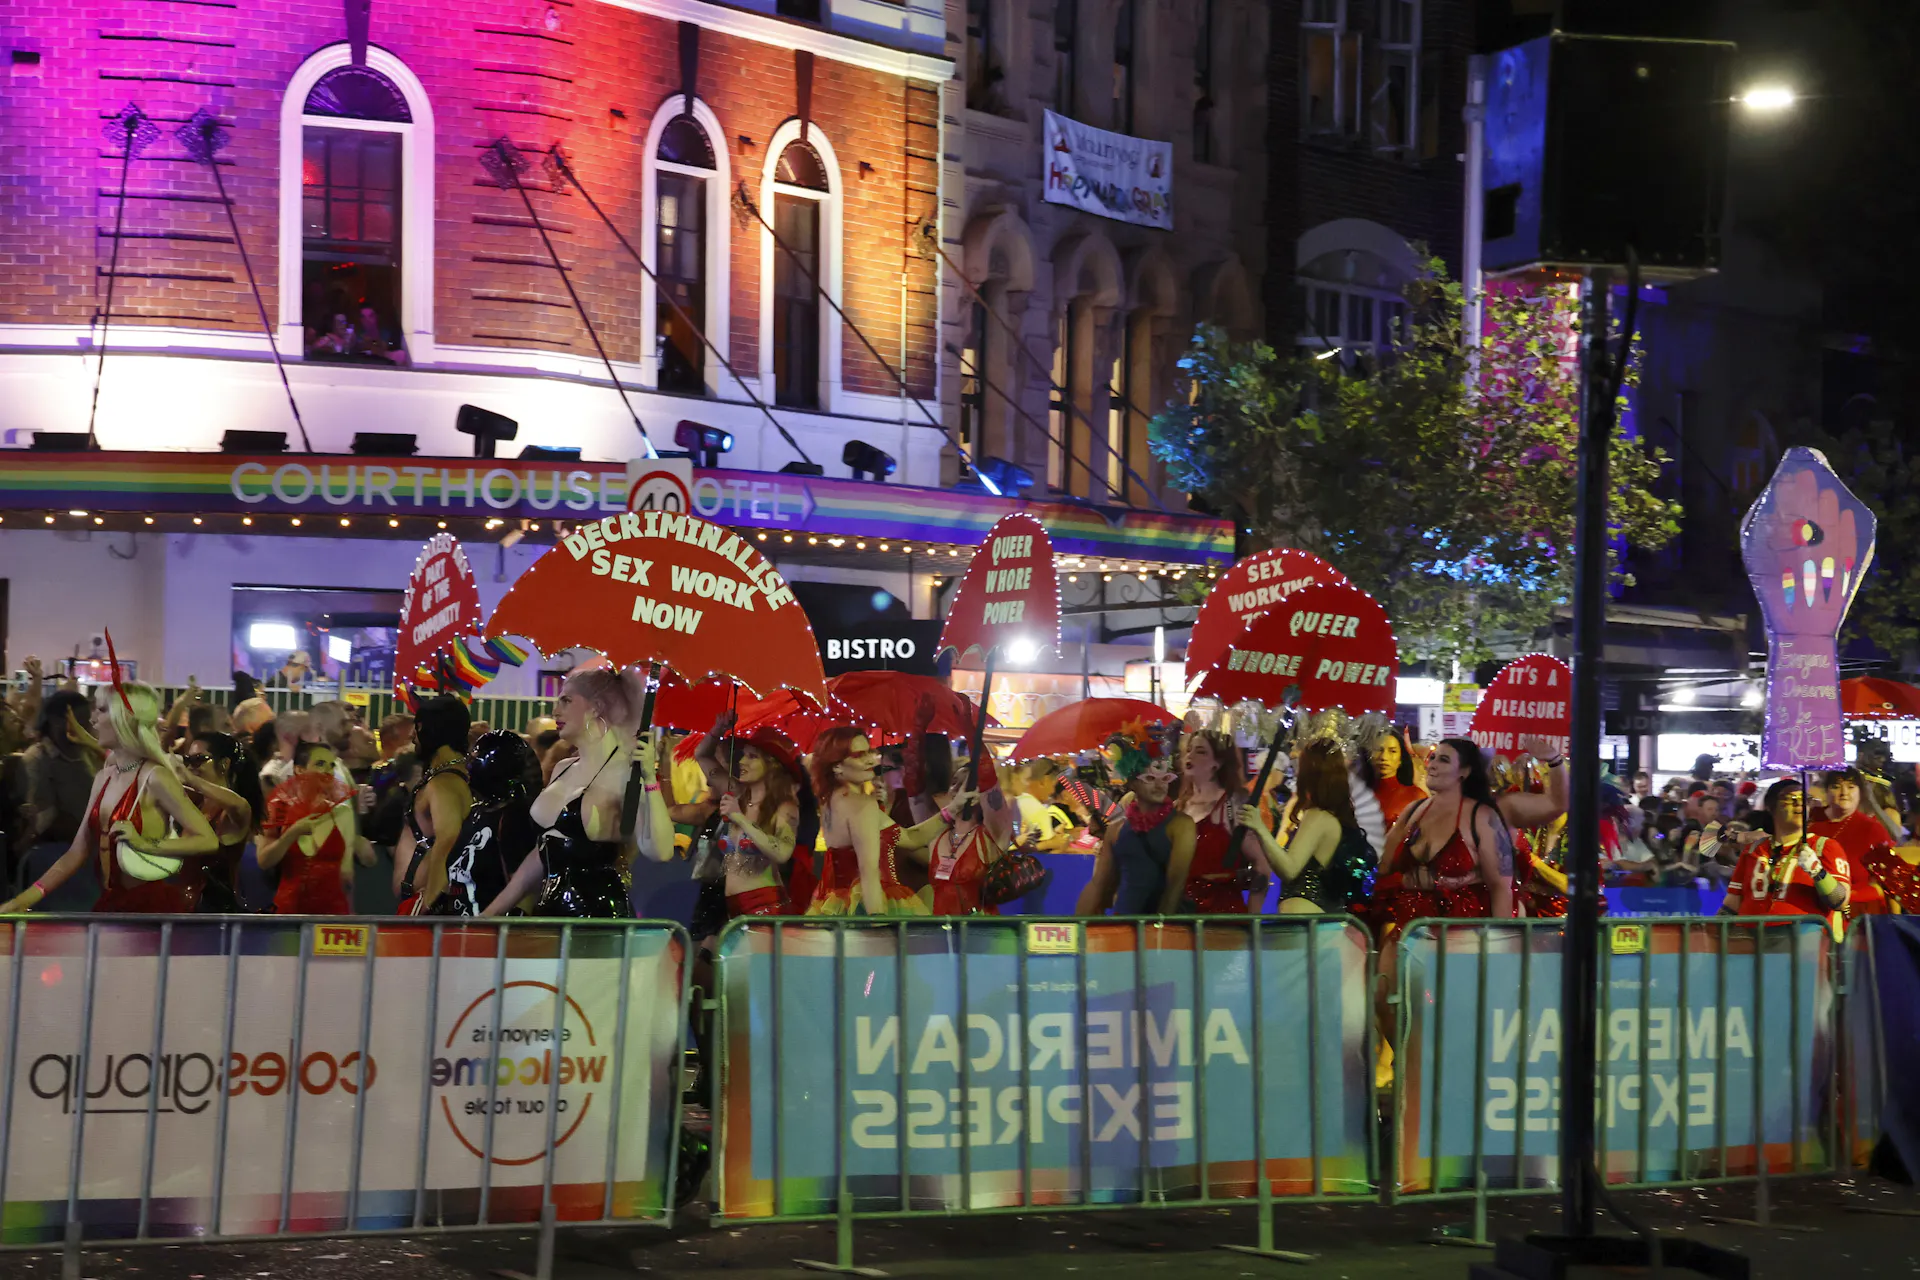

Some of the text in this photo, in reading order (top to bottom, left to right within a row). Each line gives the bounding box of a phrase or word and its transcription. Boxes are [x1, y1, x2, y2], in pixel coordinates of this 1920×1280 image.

[230, 462, 791, 522] COURTHOUSE OTEL
[564, 512, 794, 611] DECRIMINALISE
[991, 535, 1033, 566] QUEER
[425, 558, 446, 587] PART
[592, 549, 759, 612] SEX WORK
[985, 567, 1032, 593] WHORE
[1247, 558, 1285, 583] SEX
[434, 578, 450, 604] THE
[413, 601, 460, 646] COMMUNITY
[631, 596, 703, 635] NOW
[983, 600, 1025, 625] POWER
[1289, 611, 1360, 638] QUEER
[827, 638, 916, 659] BISTRO
[1227, 649, 1391, 686] WHORE POWER
[1507, 665, 1558, 687] IT'S A
[1492, 698, 1566, 719] PLEASURE
[1471, 729, 1514, 751] DOING
[1775, 722, 1837, 765] FREE
[1034, 926, 1070, 943] TFH
